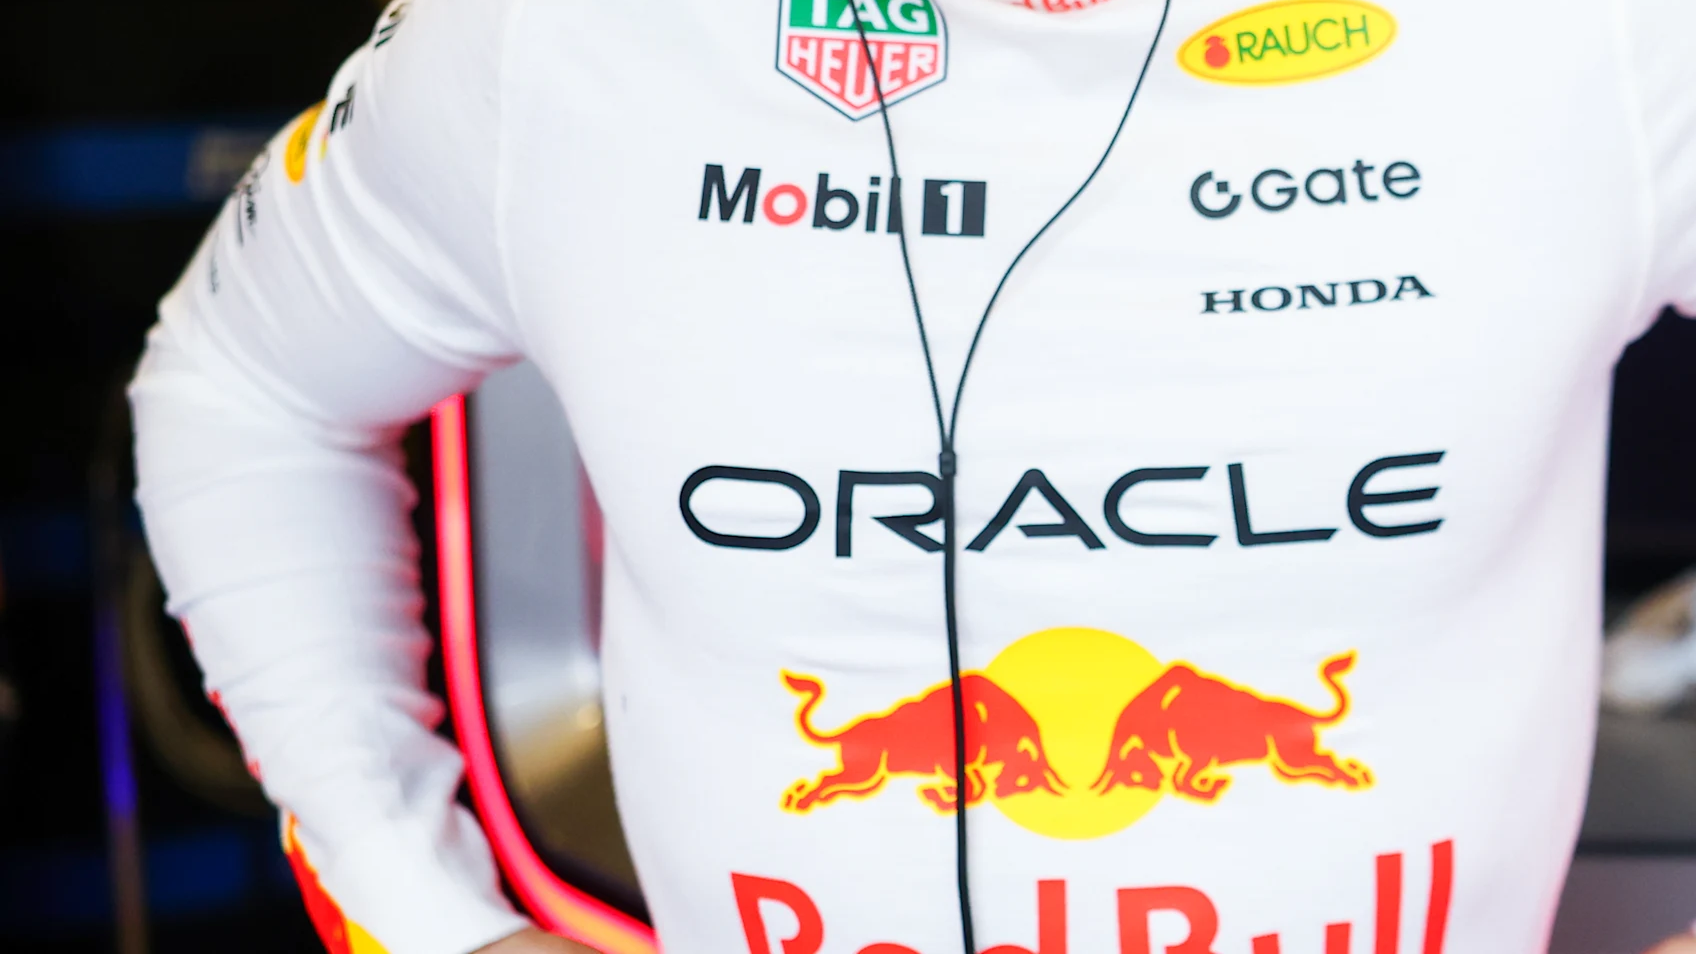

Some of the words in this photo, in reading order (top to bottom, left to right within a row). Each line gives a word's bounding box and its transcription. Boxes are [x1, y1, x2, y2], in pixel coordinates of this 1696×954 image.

[790, 36, 937, 103] HEUER
[1236, 13, 1371, 64] RAUCH
[698, 163, 901, 234] Mobil
[1251, 159, 1421, 212] Gate
[1200, 275, 1436, 314] HONDA
[679, 450, 1446, 557] ORACLE
[730, 871, 1068, 954] Rd
